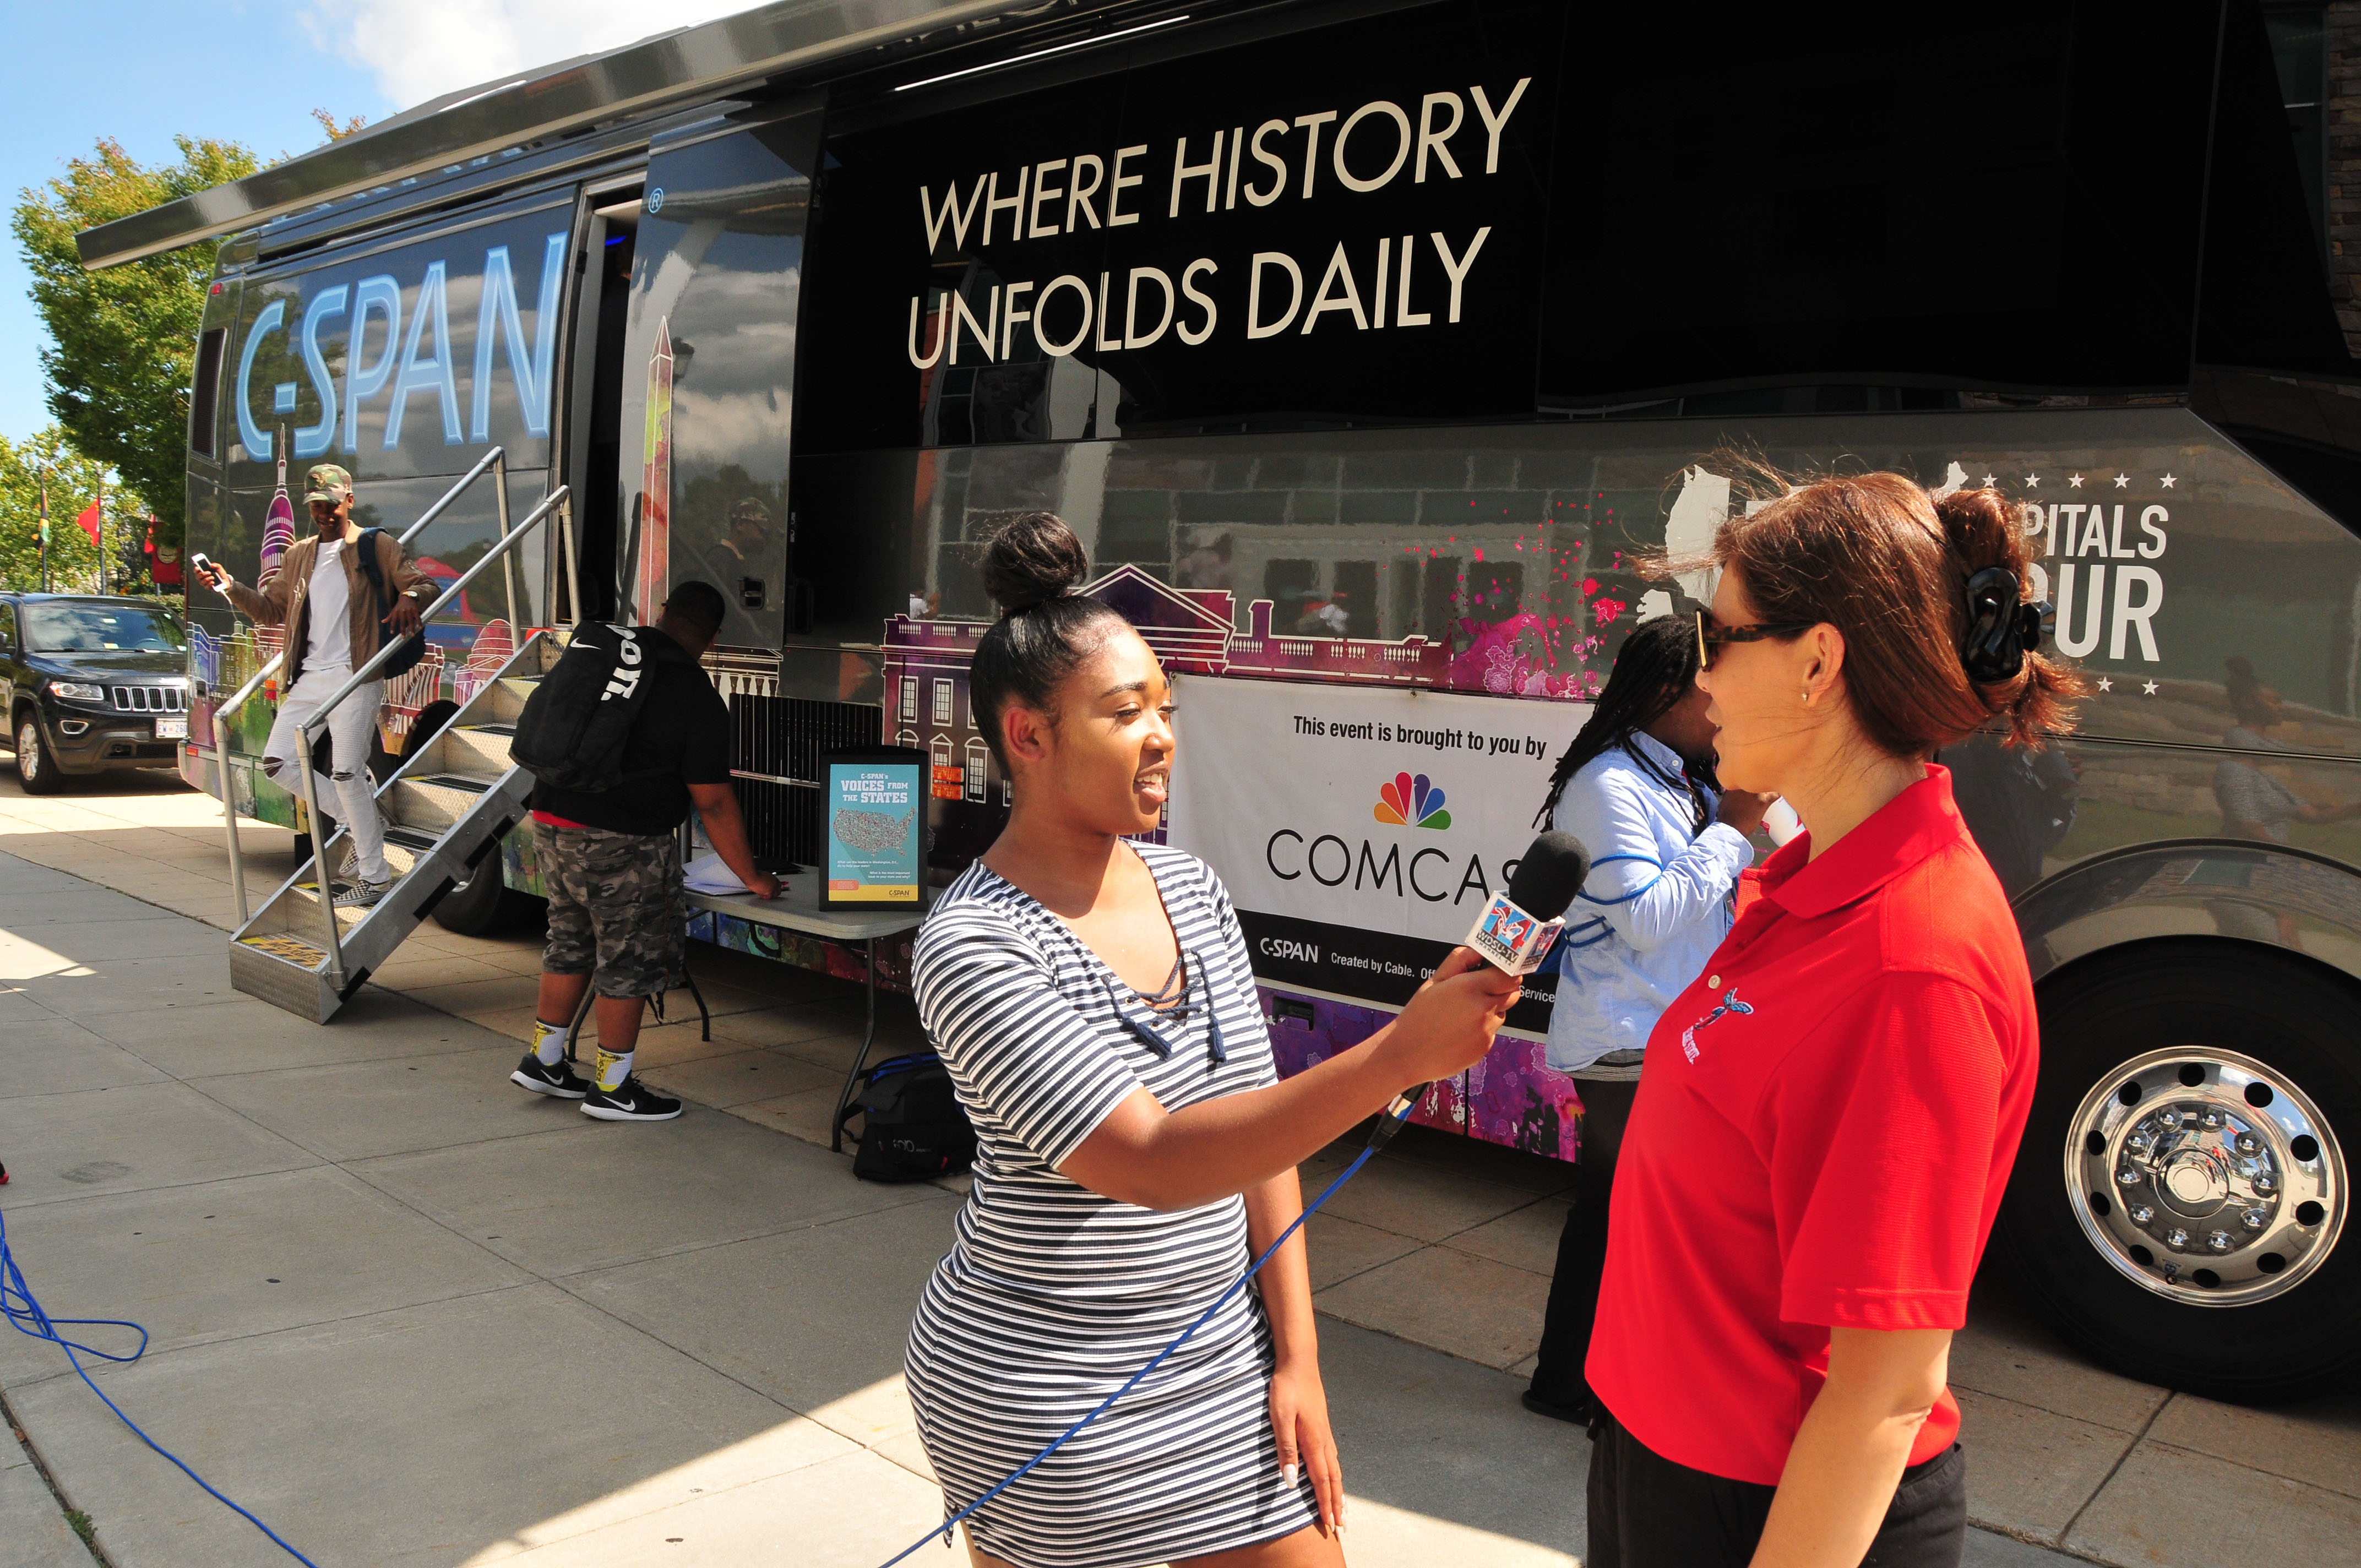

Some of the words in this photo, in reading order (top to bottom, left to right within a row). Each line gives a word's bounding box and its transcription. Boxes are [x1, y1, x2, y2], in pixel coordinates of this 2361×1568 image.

[920, 144, 1147, 255] WHERE
[1169, 77, 1532, 219] HISTORY
[908, 258, 1218, 370] UNFOLDS
[1247, 226, 1492, 340] DAILY
[235, 231, 569, 463] C-SPAN
[2022, 504, 2169, 559] PITALS
[1293, 715, 1325, 736] This
[1330, 722, 1373, 741] event
[1378, 722, 1392, 742] is
[1397, 724, 1463, 751] brought
[1467, 731, 1484, 751] to
[1488, 737, 1521, 756] you
[1525, 736, 1548, 761] by
[841, 780, 885, 791] VOICES
[861, 792, 908, 803] STATES
[1266, 829, 1521, 906] COMCA
[1260, 937, 1319, 963] C-SPAN
[1475, 939, 1502, 960] CHANNEL
[1477, 930, 1519, 962] WDSU-TV
[1331, 952, 1369, 969] Created
[1371, 959, 1383, 974] by
[1385, 961, 1415, 977] Cable.
[1519, 985, 1556, 1003] Service
